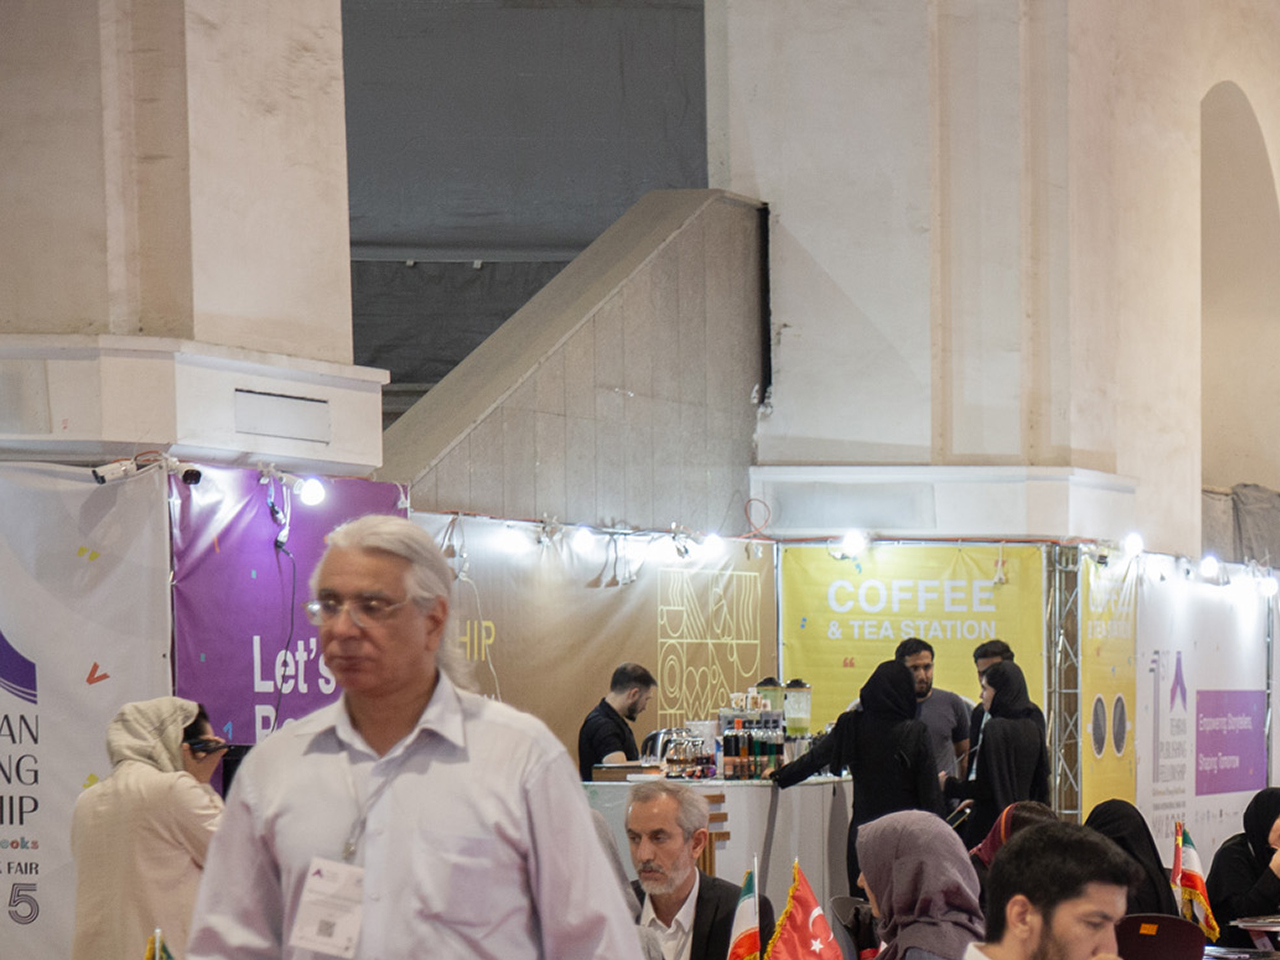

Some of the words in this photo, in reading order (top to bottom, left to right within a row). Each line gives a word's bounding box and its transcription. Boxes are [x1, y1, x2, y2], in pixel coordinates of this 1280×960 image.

[827, 579, 996, 613] COFFEE
[827, 620, 843, 640] &
[849, 620, 894, 640] TEA
[900, 619, 996, 640] STATION
[7, 861, 39, 875] FAIR
